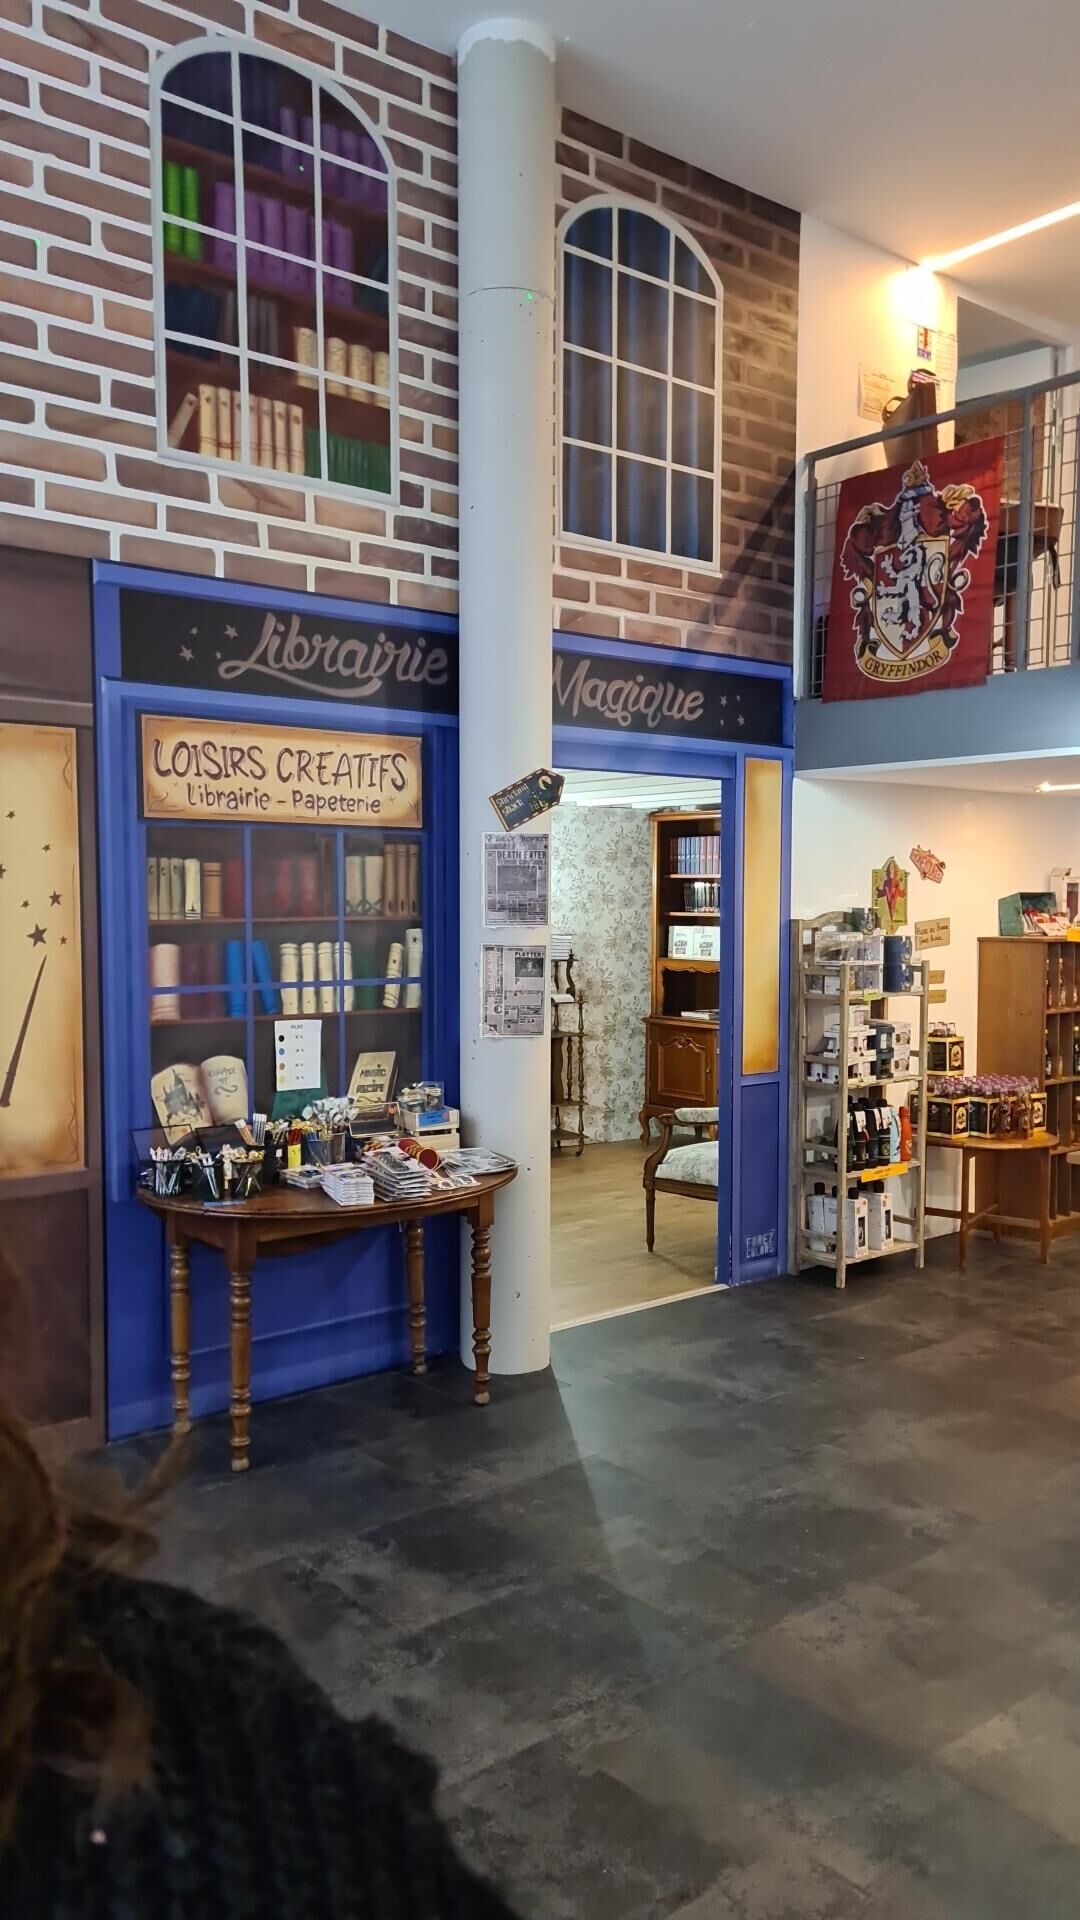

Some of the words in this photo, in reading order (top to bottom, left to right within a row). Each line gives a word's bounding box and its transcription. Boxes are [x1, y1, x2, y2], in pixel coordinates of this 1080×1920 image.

[218, 612, 448, 697] Librairie
[552, 655, 704, 728] Magique
[864, 650, 943, 676] GRYFFINDOR
[153, 739, 267, 780] LOISIRS
[276, 747, 408, 792] CREATIFS
[292, 789, 381, 816] Papeterie
[497, 851, 521, 859] DEATH
[524, 851, 547, 859] EATER
